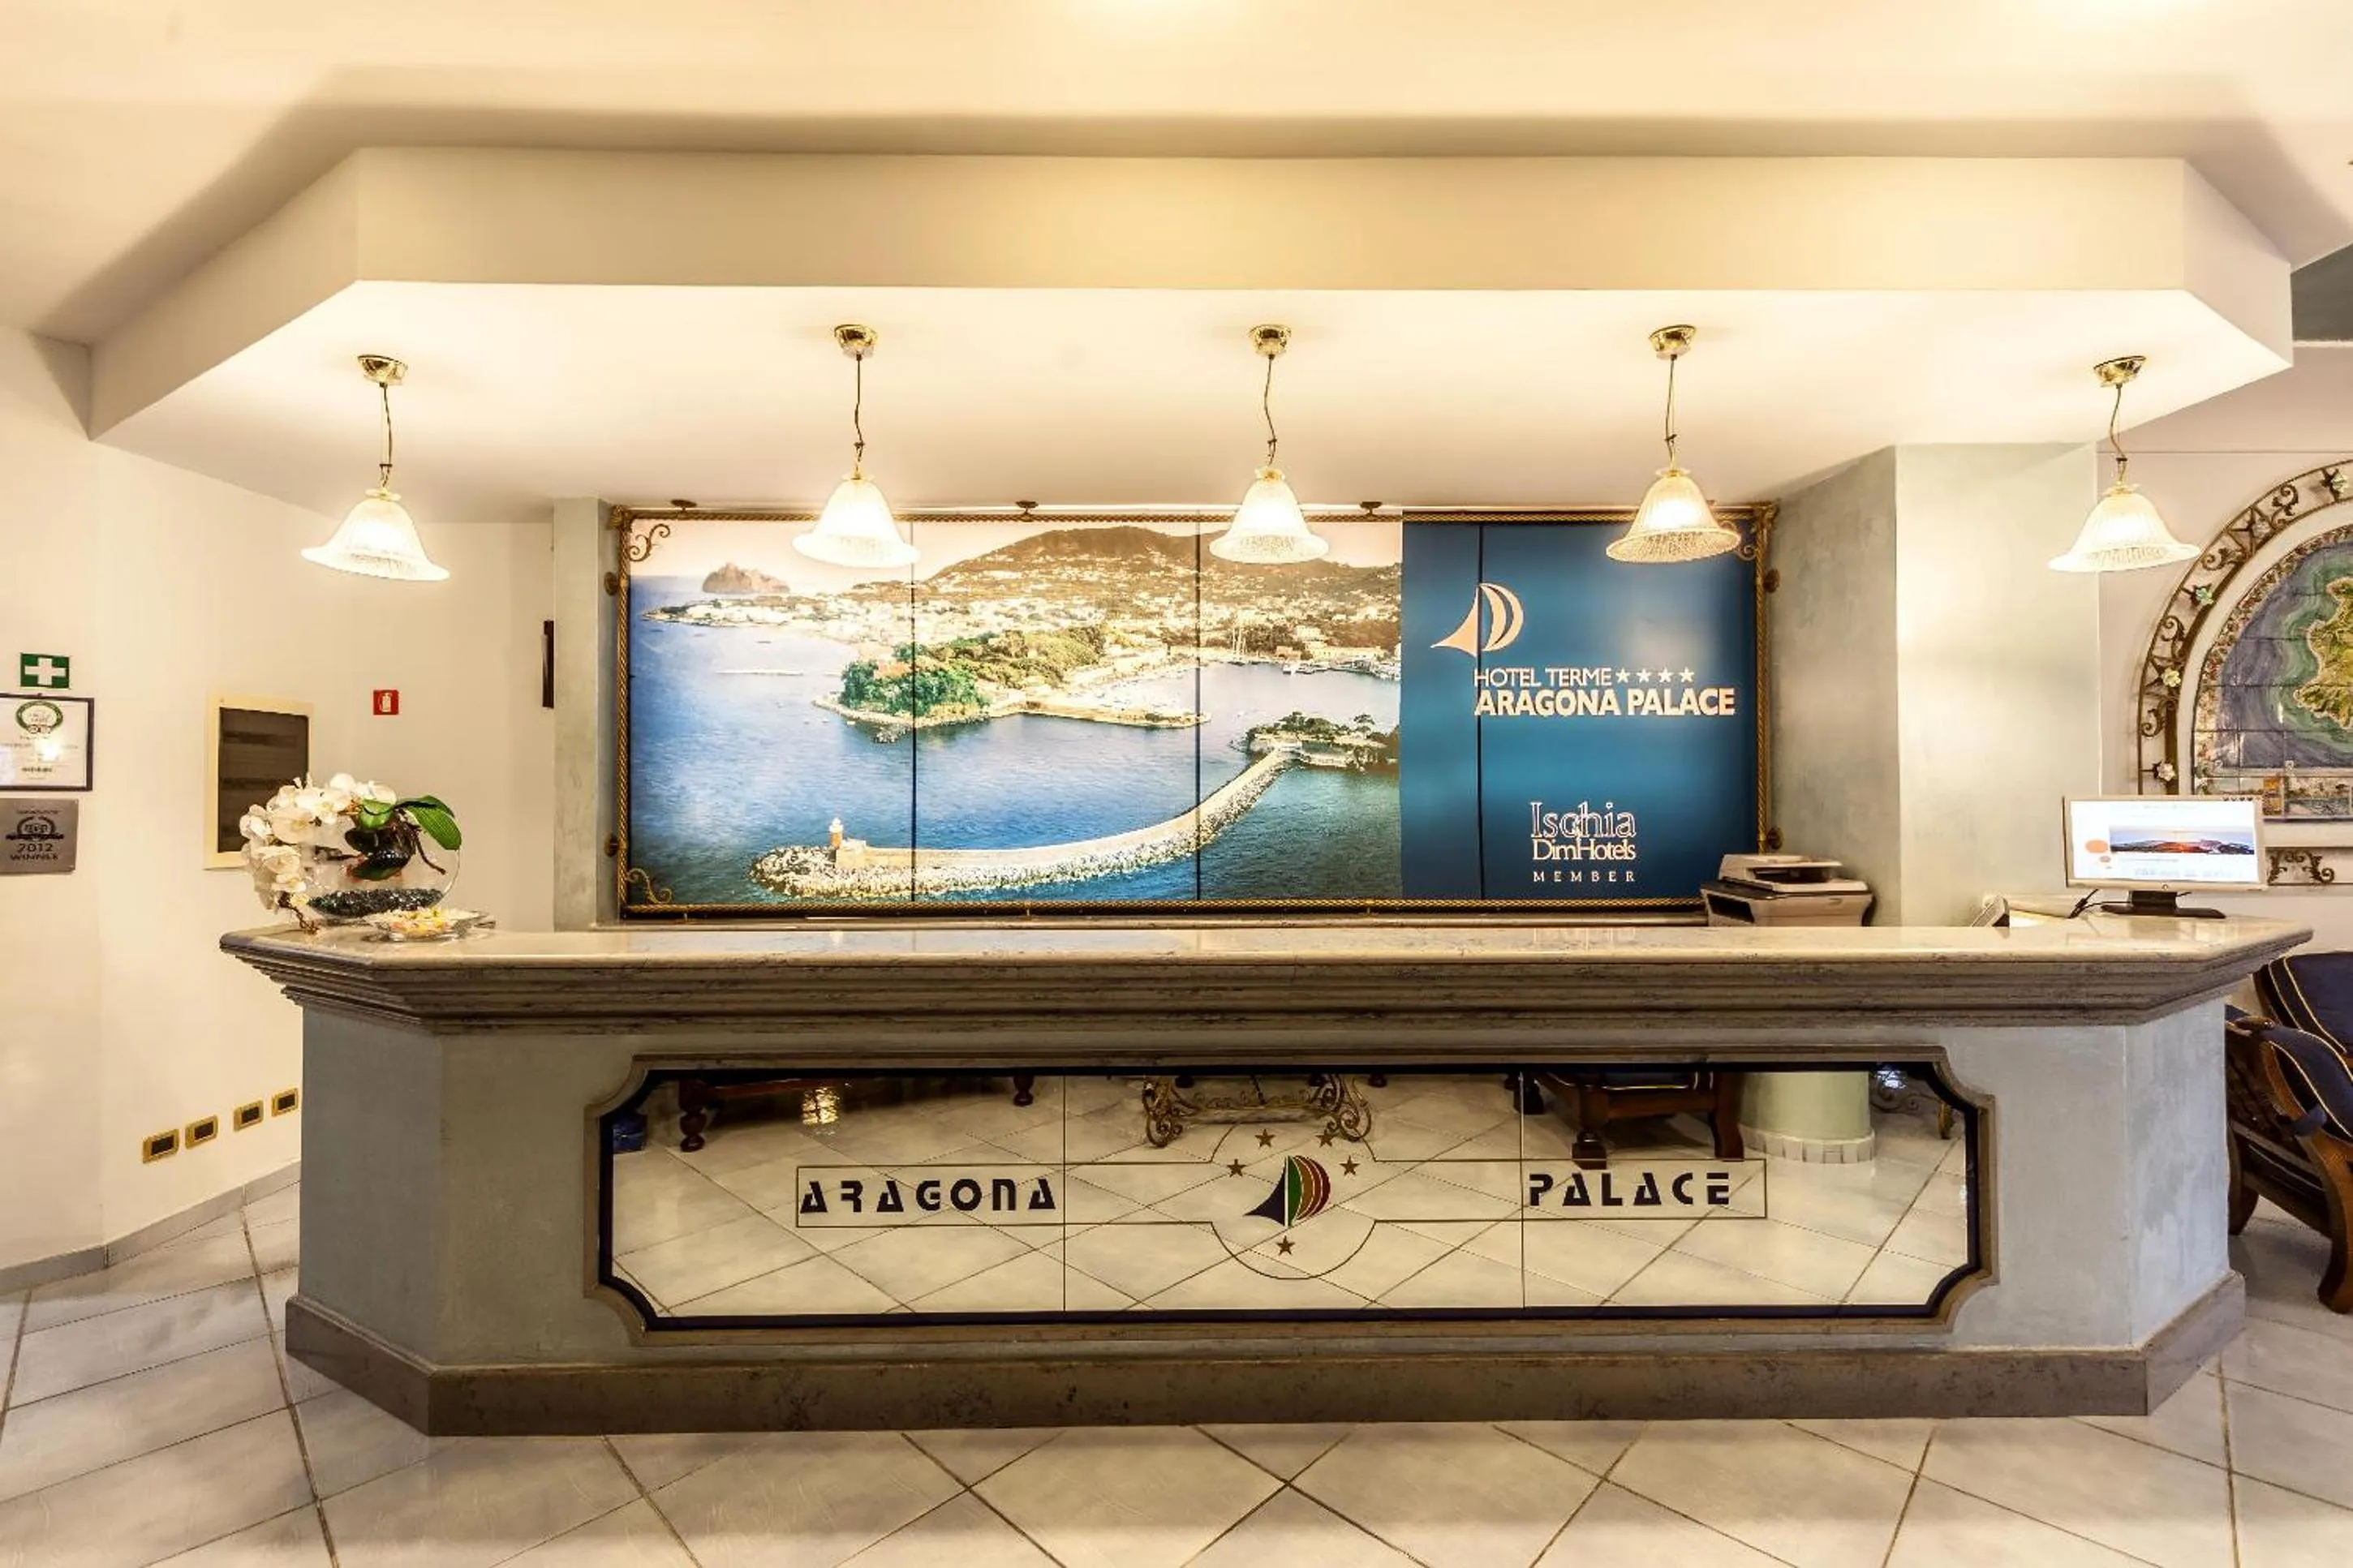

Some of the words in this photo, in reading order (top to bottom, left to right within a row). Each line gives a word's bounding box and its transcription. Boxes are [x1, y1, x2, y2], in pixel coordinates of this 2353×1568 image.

[1473, 668, 1541, 688] HOTEL
[1545, 668, 1612, 687] TERME
[1473, 689, 1621, 716] ARAGONA
[1628, 688, 1736, 716] PALACE
[1530, 801, 1637, 838] Ischia
[17, 843, 54, 853] 2012
[1533, 870, 1636, 883] MEMBER
[800, 1179, 1056, 1214] ARAGONA
[1529, 1172, 1729, 1206] PALACE
